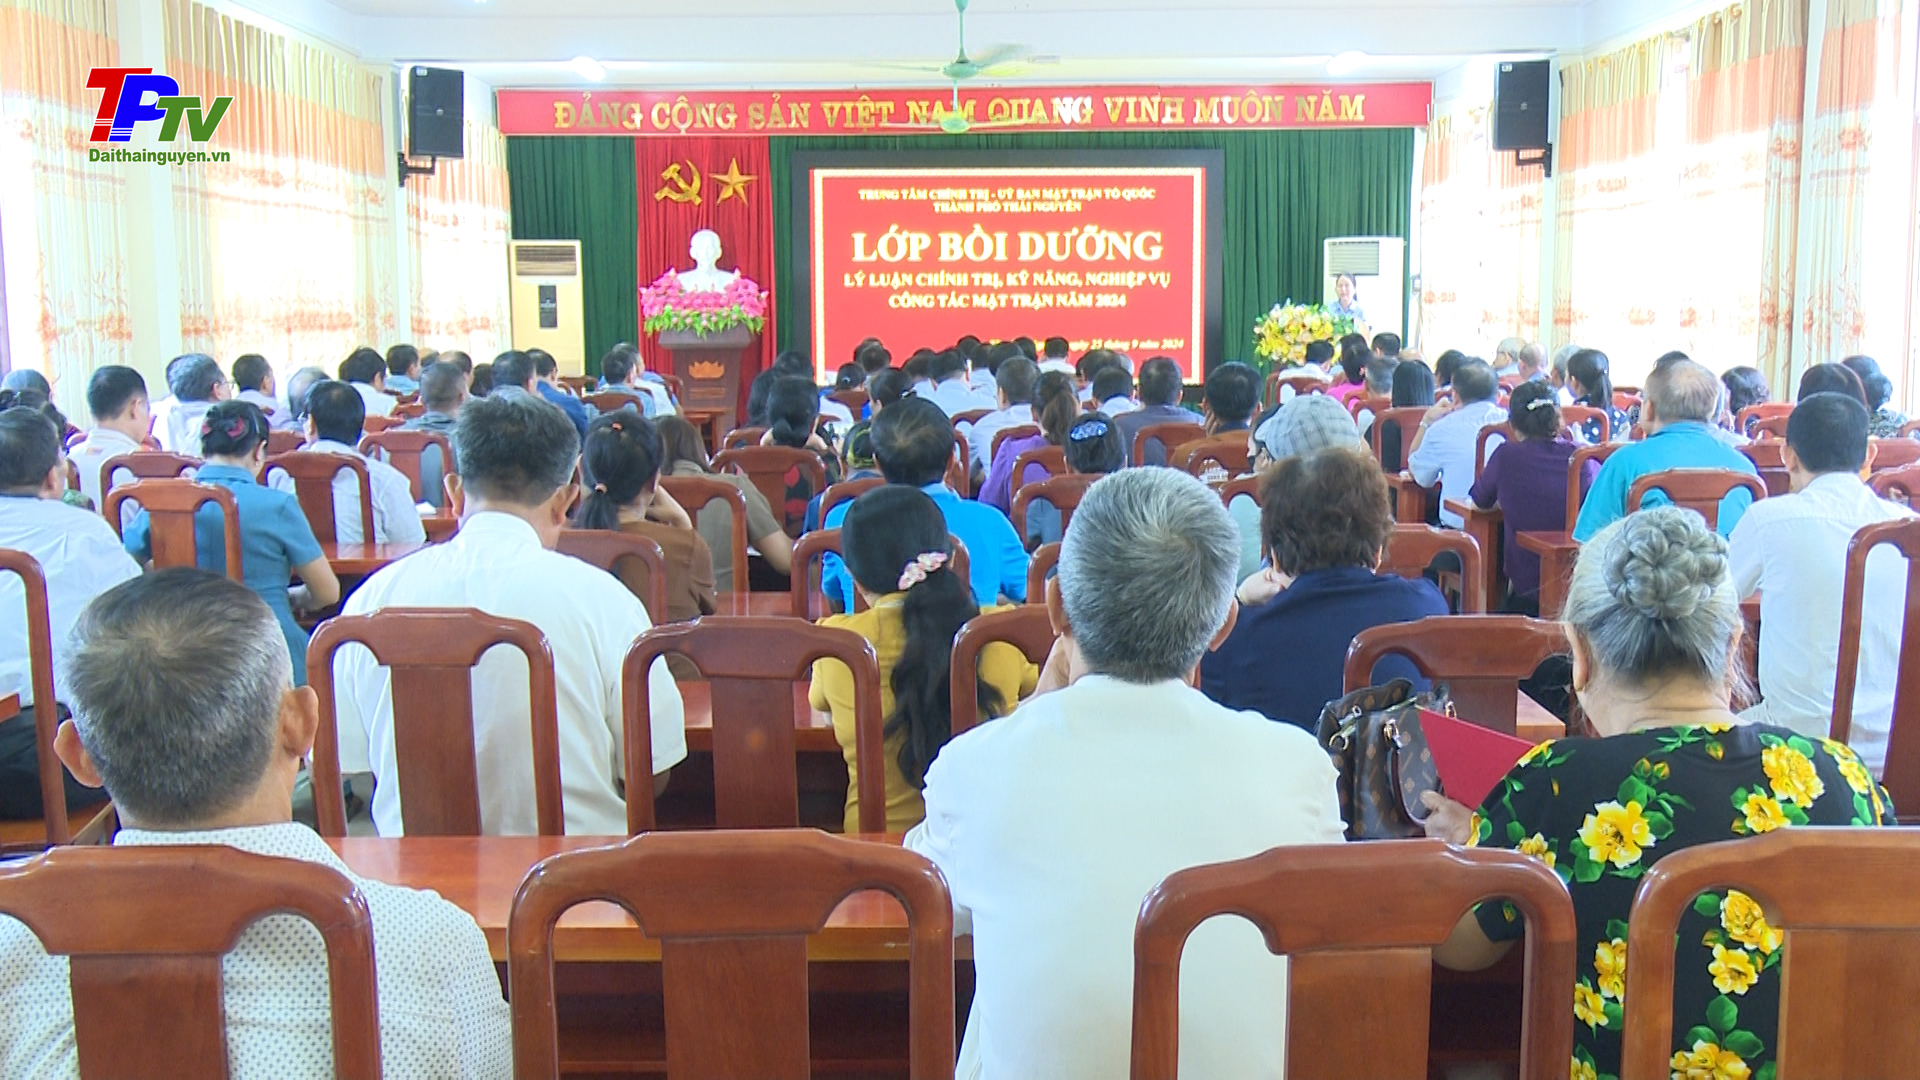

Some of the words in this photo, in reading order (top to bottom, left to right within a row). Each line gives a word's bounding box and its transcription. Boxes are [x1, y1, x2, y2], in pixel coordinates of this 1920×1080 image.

[553, 91, 643, 130] ĐẢNG
[651, 94, 738, 135] CỘNG
[748, 92, 811, 130] SẢN
[820, 94, 894, 133] VIỆT
[906, 99, 976, 125] NAM
[987, 96, 1094, 125] QUANG
[1104, 95, 1185, 123] VINH
[1193, 89, 1284, 123] MUÔN
[1296, 89, 1365, 122] NĂM
[858, 188, 899, 200] TRUNG
[901, 187, 928, 200] TÂM
[928, 187, 968, 200] CHÍNH
[969, 188, 990, 202] TRỊ
[1016, 188, 1041, 200] BAN
[933, 199, 975, 213] THÀNH
[1002, 199, 1031, 213] THÁI
[1033, 199, 1082, 213] NGUYÊN
[851, 223, 931, 262] LỚP
[937, 223, 1009, 262] BỒI
[1017, 224, 1163, 262] DƯỠNG
[843, 269, 866, 287] LÝ
[869, 271, 913, 290] LUẬN
[915, 269, 969, 287] CHÍNH
[971, 272, 1004, 289] TRỊ,
[1006, 269, 1029, 287] KỸ
[1032, 269, 1083, 288] NĂNG,
[1085, 270, 1147, 289] NGHIỆP
[1148, 271, 1171, 289] VỤ
[888, 290, 935, 308] CÔNG
[937, 290, 970, 308] TÁC
[1009, 291, 1054, 311] TRẬN
[1055, 290, 1094, 308] NĂM
[1095, 293, 1127, 308] 2024
[1138, 339, 1160, 350] năm
[1161, 338, 1184, 350] 2024
